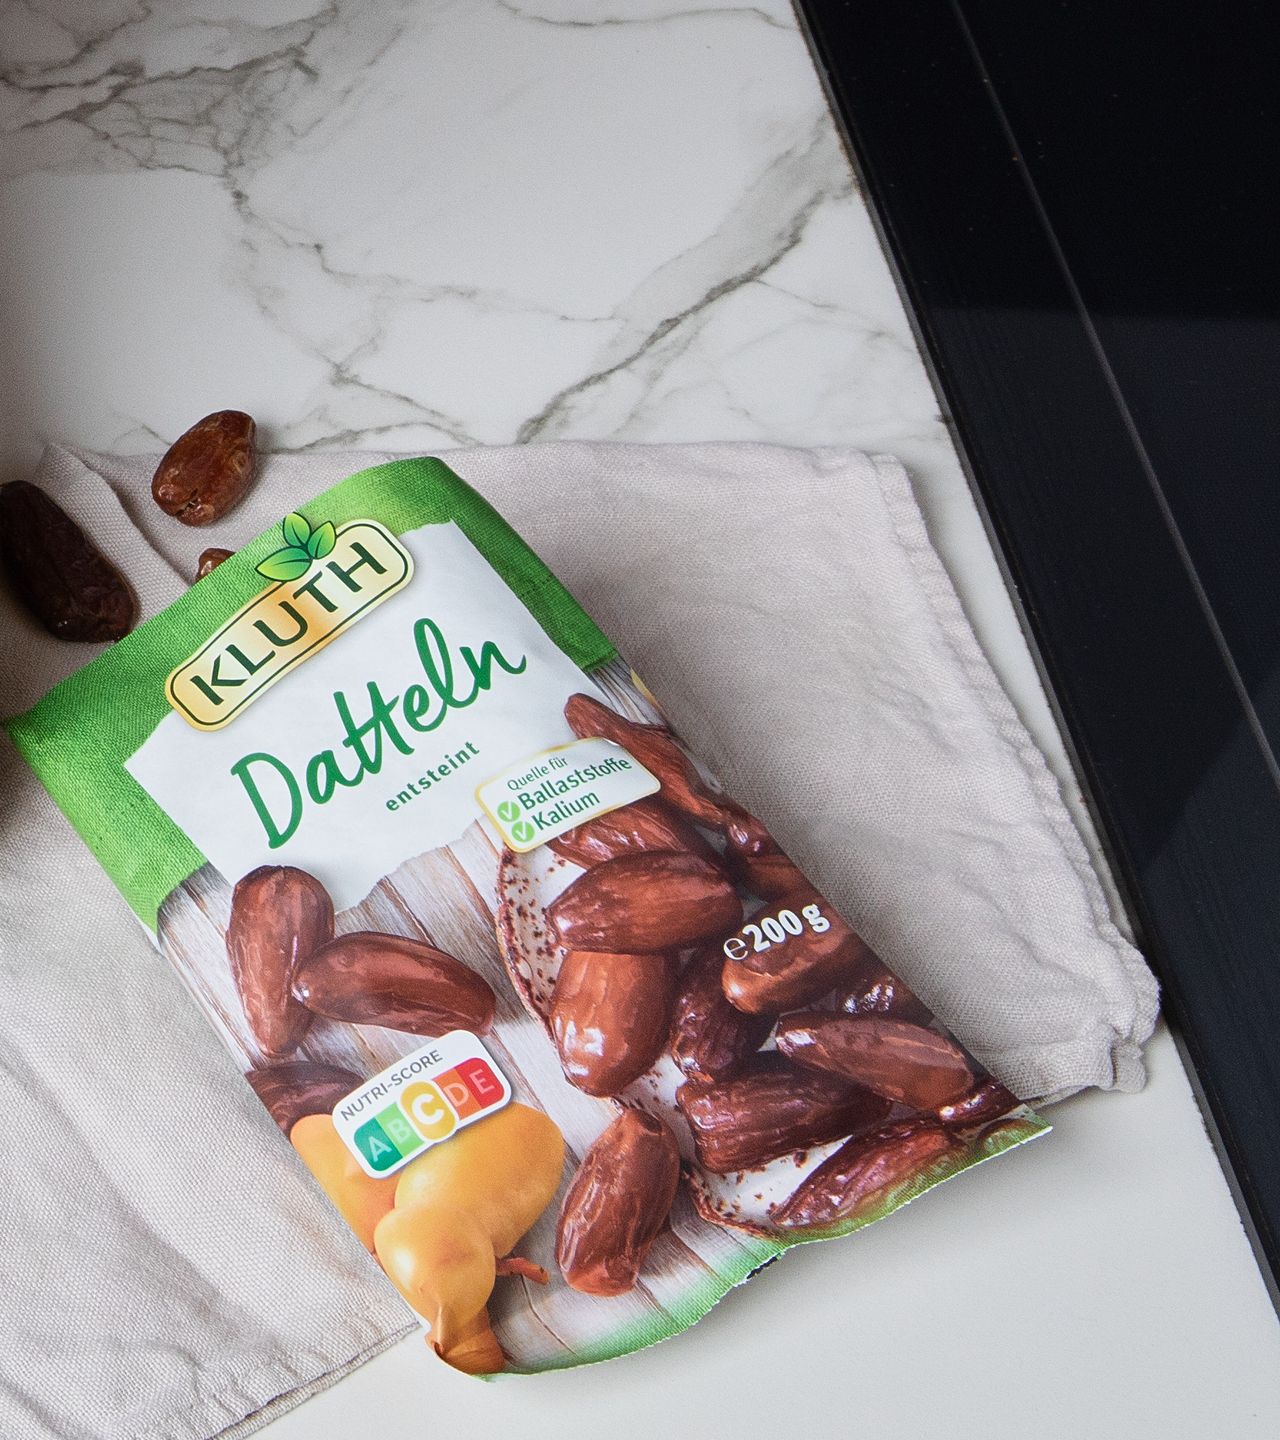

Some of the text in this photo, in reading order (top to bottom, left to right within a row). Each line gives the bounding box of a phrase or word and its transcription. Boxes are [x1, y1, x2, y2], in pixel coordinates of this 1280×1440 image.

[190, 541, 388, 706] KLUTH
[230, 618, 527, 849] Datteln
[385, 740, 480, 812] entsteint
[507, 756, 568, 791] Quelle für
[516, 758, 632, 810] Ballaststoffe
[530, 791, 600, 831] Kalium
[340, 1049, 443, 1121] NUTRI-SCORE
[411, 1093, 444, 1126] C
